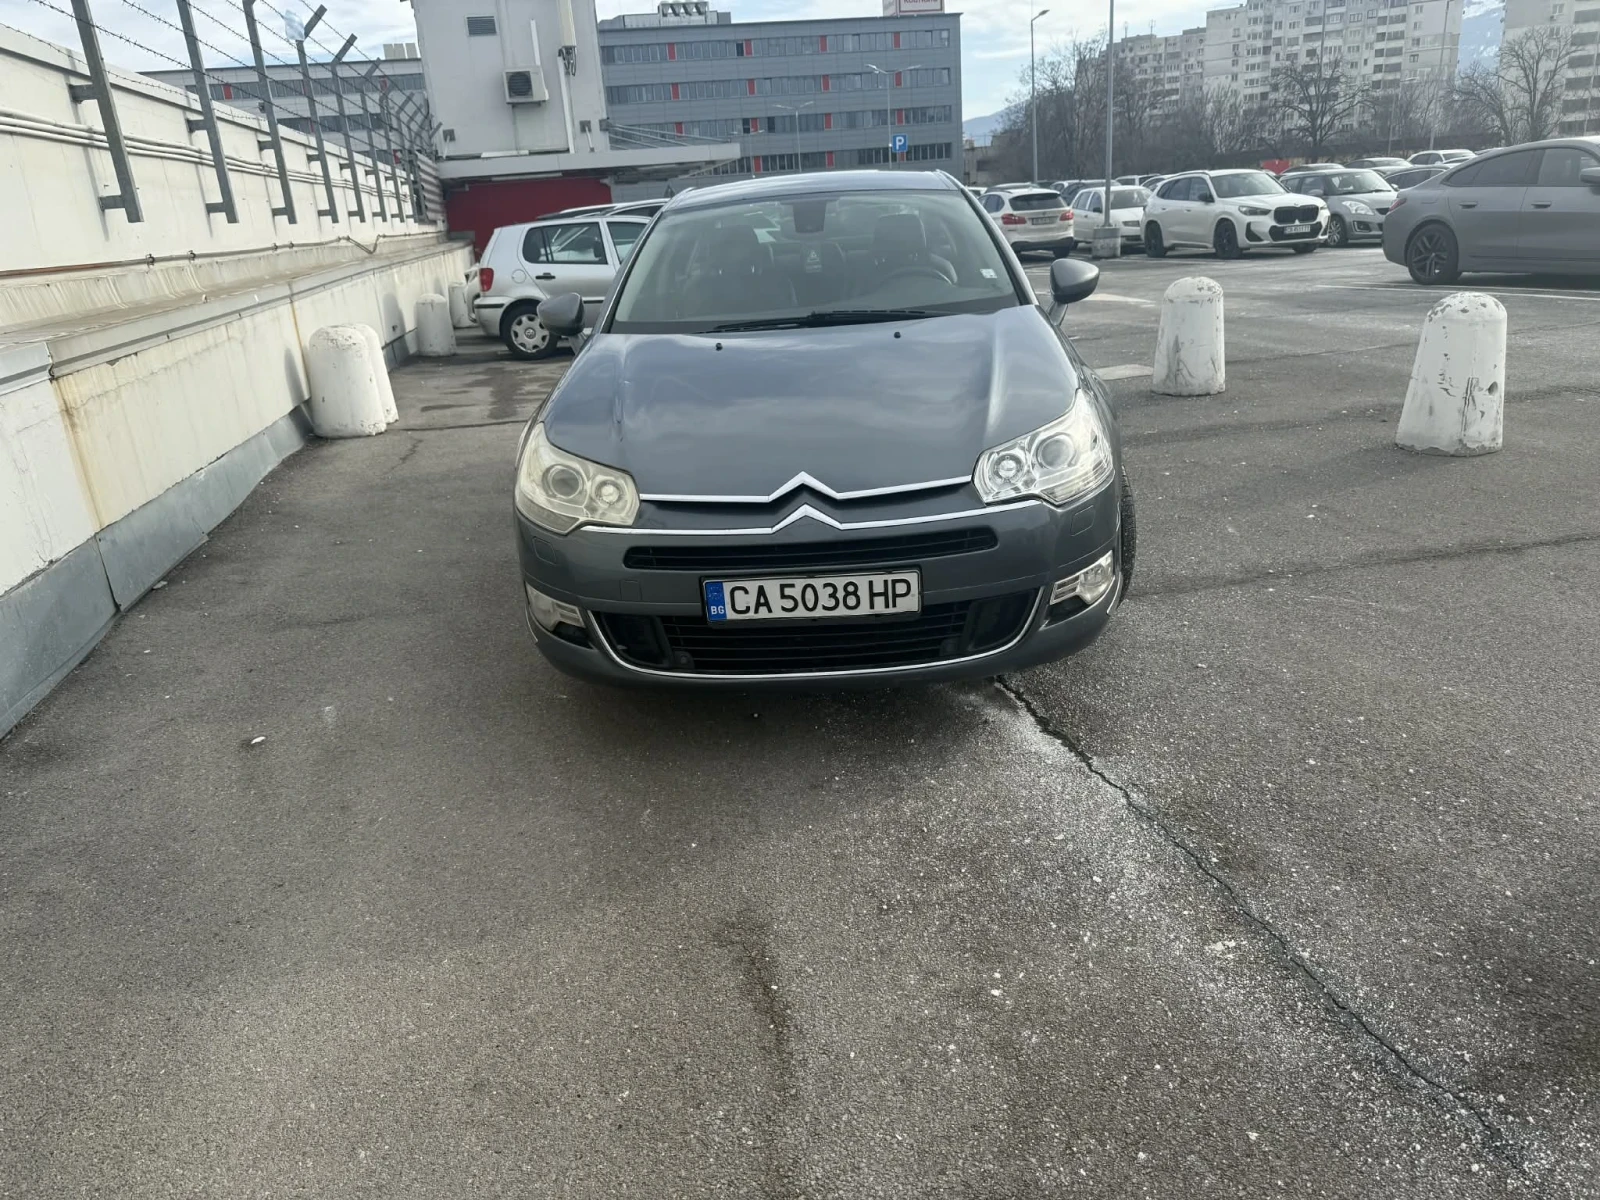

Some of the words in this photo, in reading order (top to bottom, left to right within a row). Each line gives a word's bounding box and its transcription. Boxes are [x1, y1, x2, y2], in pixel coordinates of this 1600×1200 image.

[896, 136, 904, 150] P
[729, 584, 773, 614] CA
[779, 581, 861, 612] 5038
[868, 578, 912, 610] HP
[710, 605, 725, 615] BG
